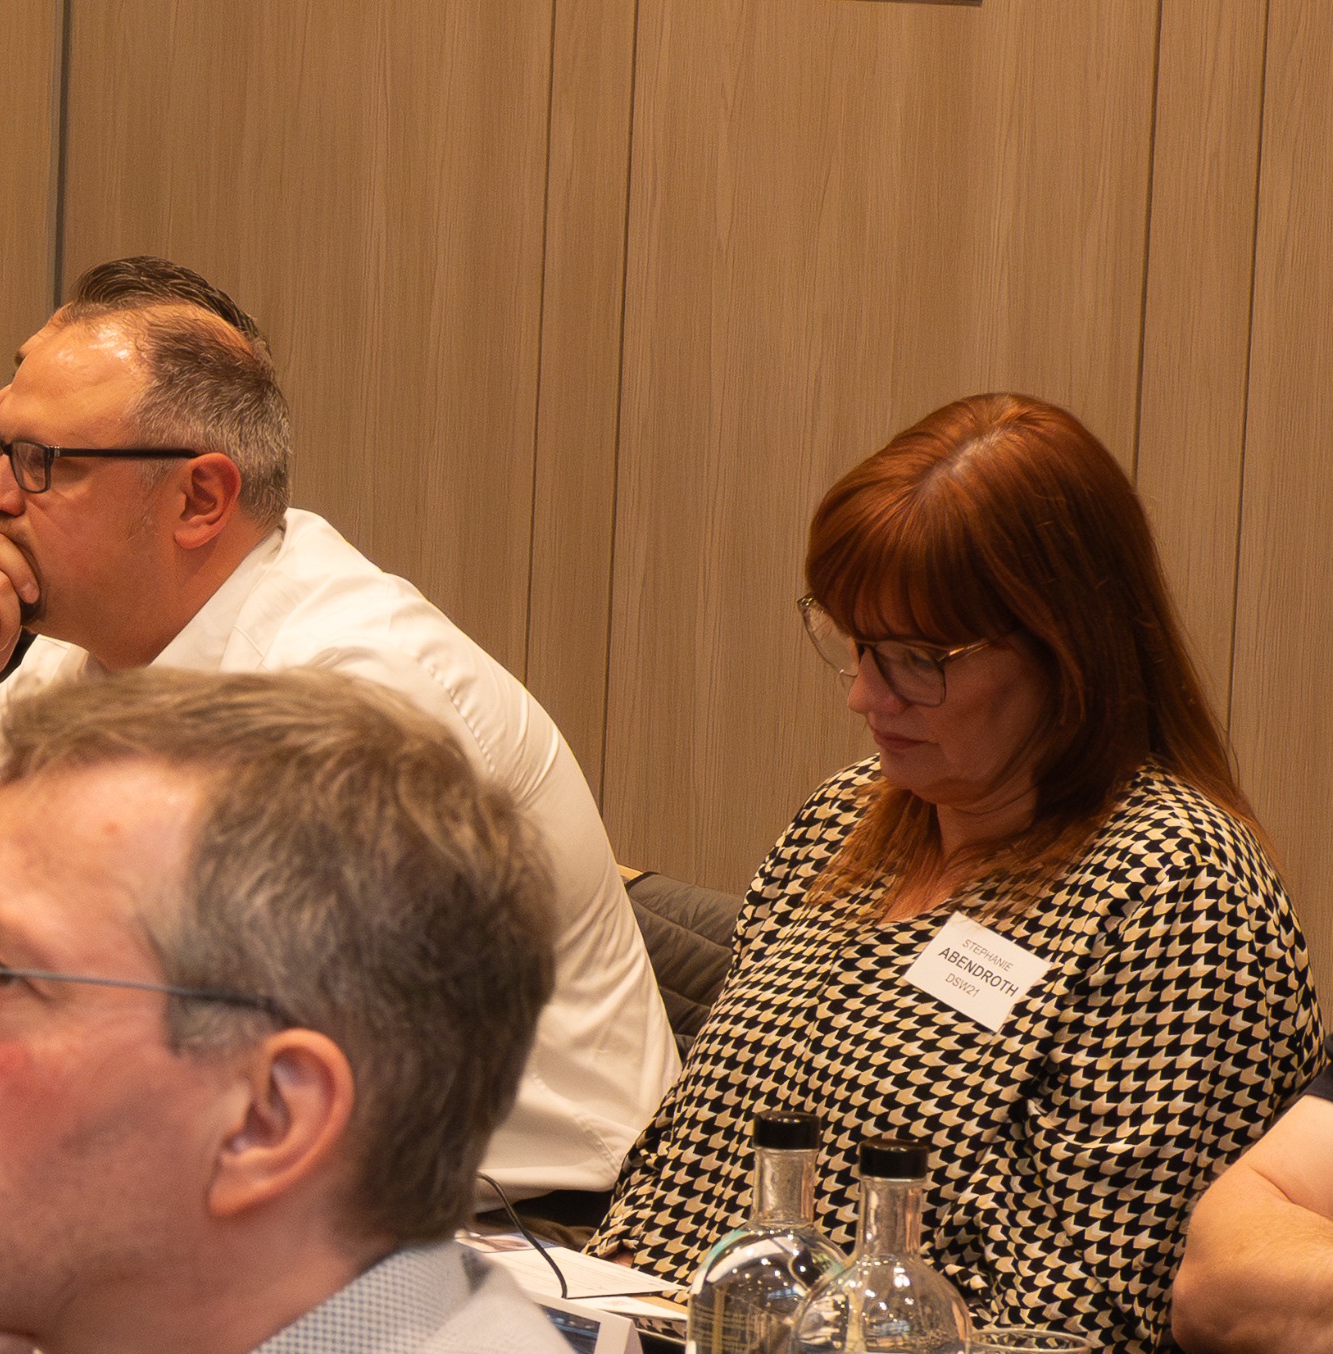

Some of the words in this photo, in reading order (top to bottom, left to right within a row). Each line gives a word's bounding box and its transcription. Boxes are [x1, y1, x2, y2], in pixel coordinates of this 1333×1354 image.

[938, 947, 1019, 997] ABENDROTH
[962, 939, 1014, 972] STEPHANIE
[945, 973, 980, 998] DSW21
